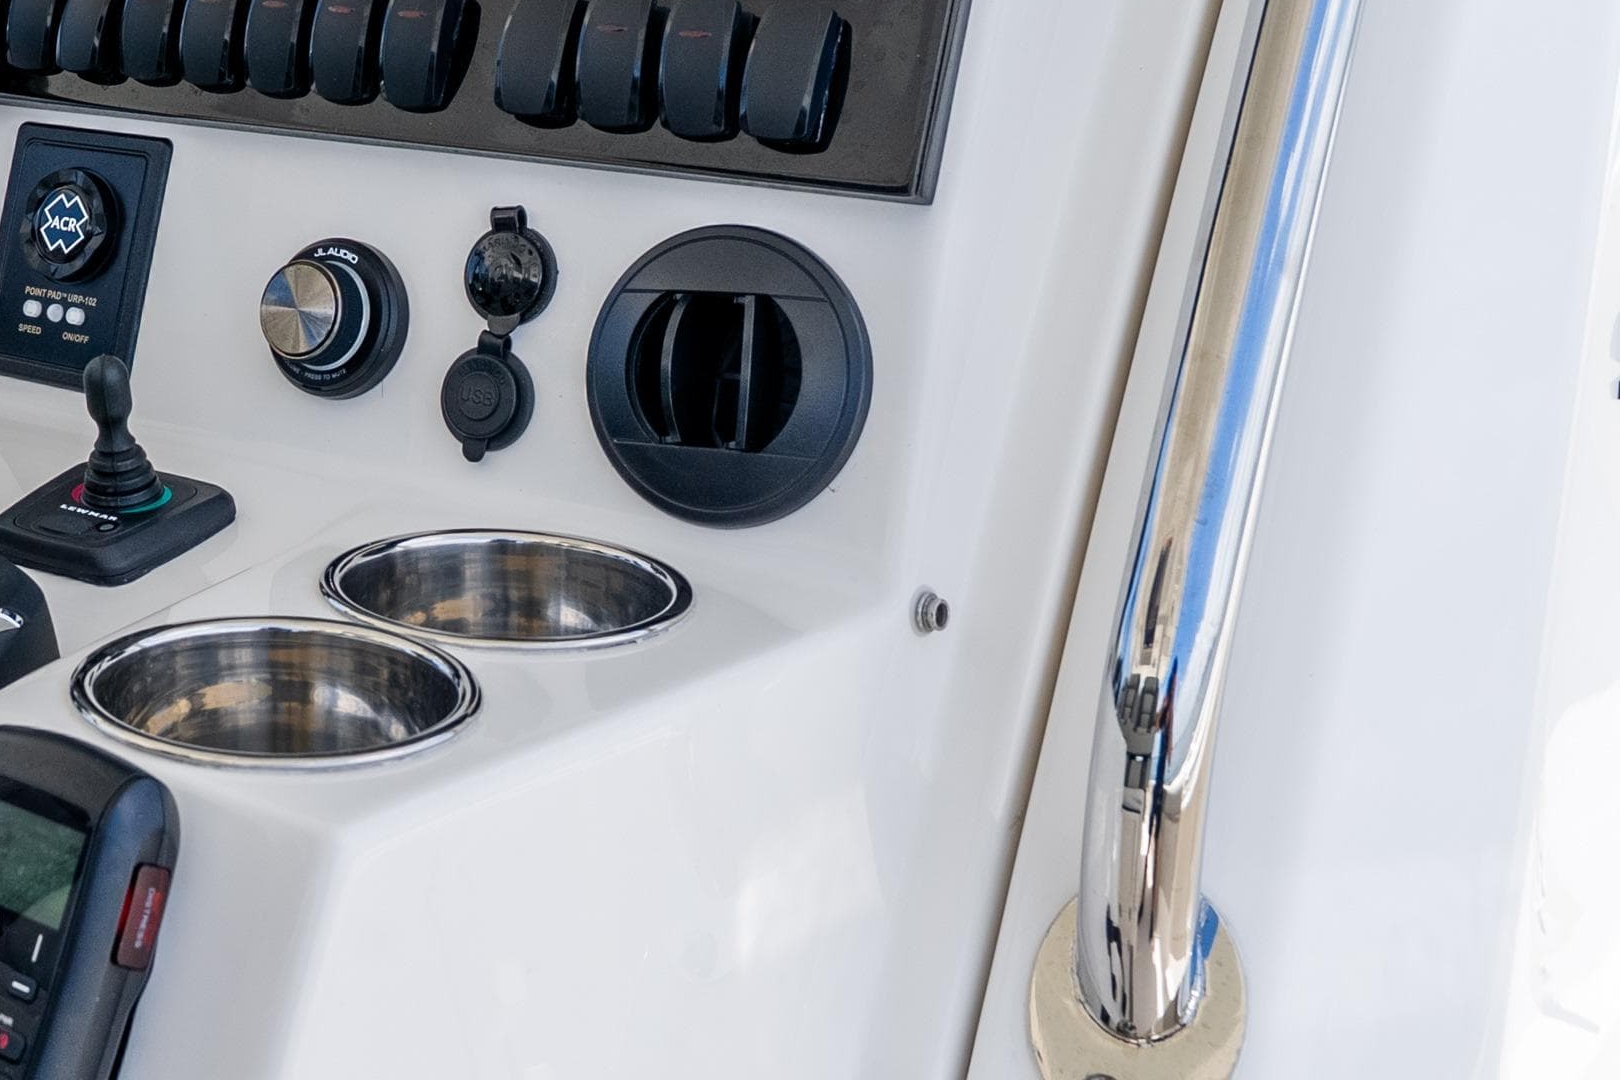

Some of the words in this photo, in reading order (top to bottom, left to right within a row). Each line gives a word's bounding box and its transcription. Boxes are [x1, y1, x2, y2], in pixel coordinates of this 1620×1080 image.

[51, 216, 77, 232] ACR
[314, 248, 326, 257] JL
[326, 246, 358, 264] AUDIO
[25, 286, 46, 298] POINT
[68, 293, 98, 307] URP-102
[18, 323, 42, 336] SPEED
[62, 332, 90, 344] ON/OFF
[460, 385, 494, 406] USB
[60, 504, 118, 521] LEWMAR
